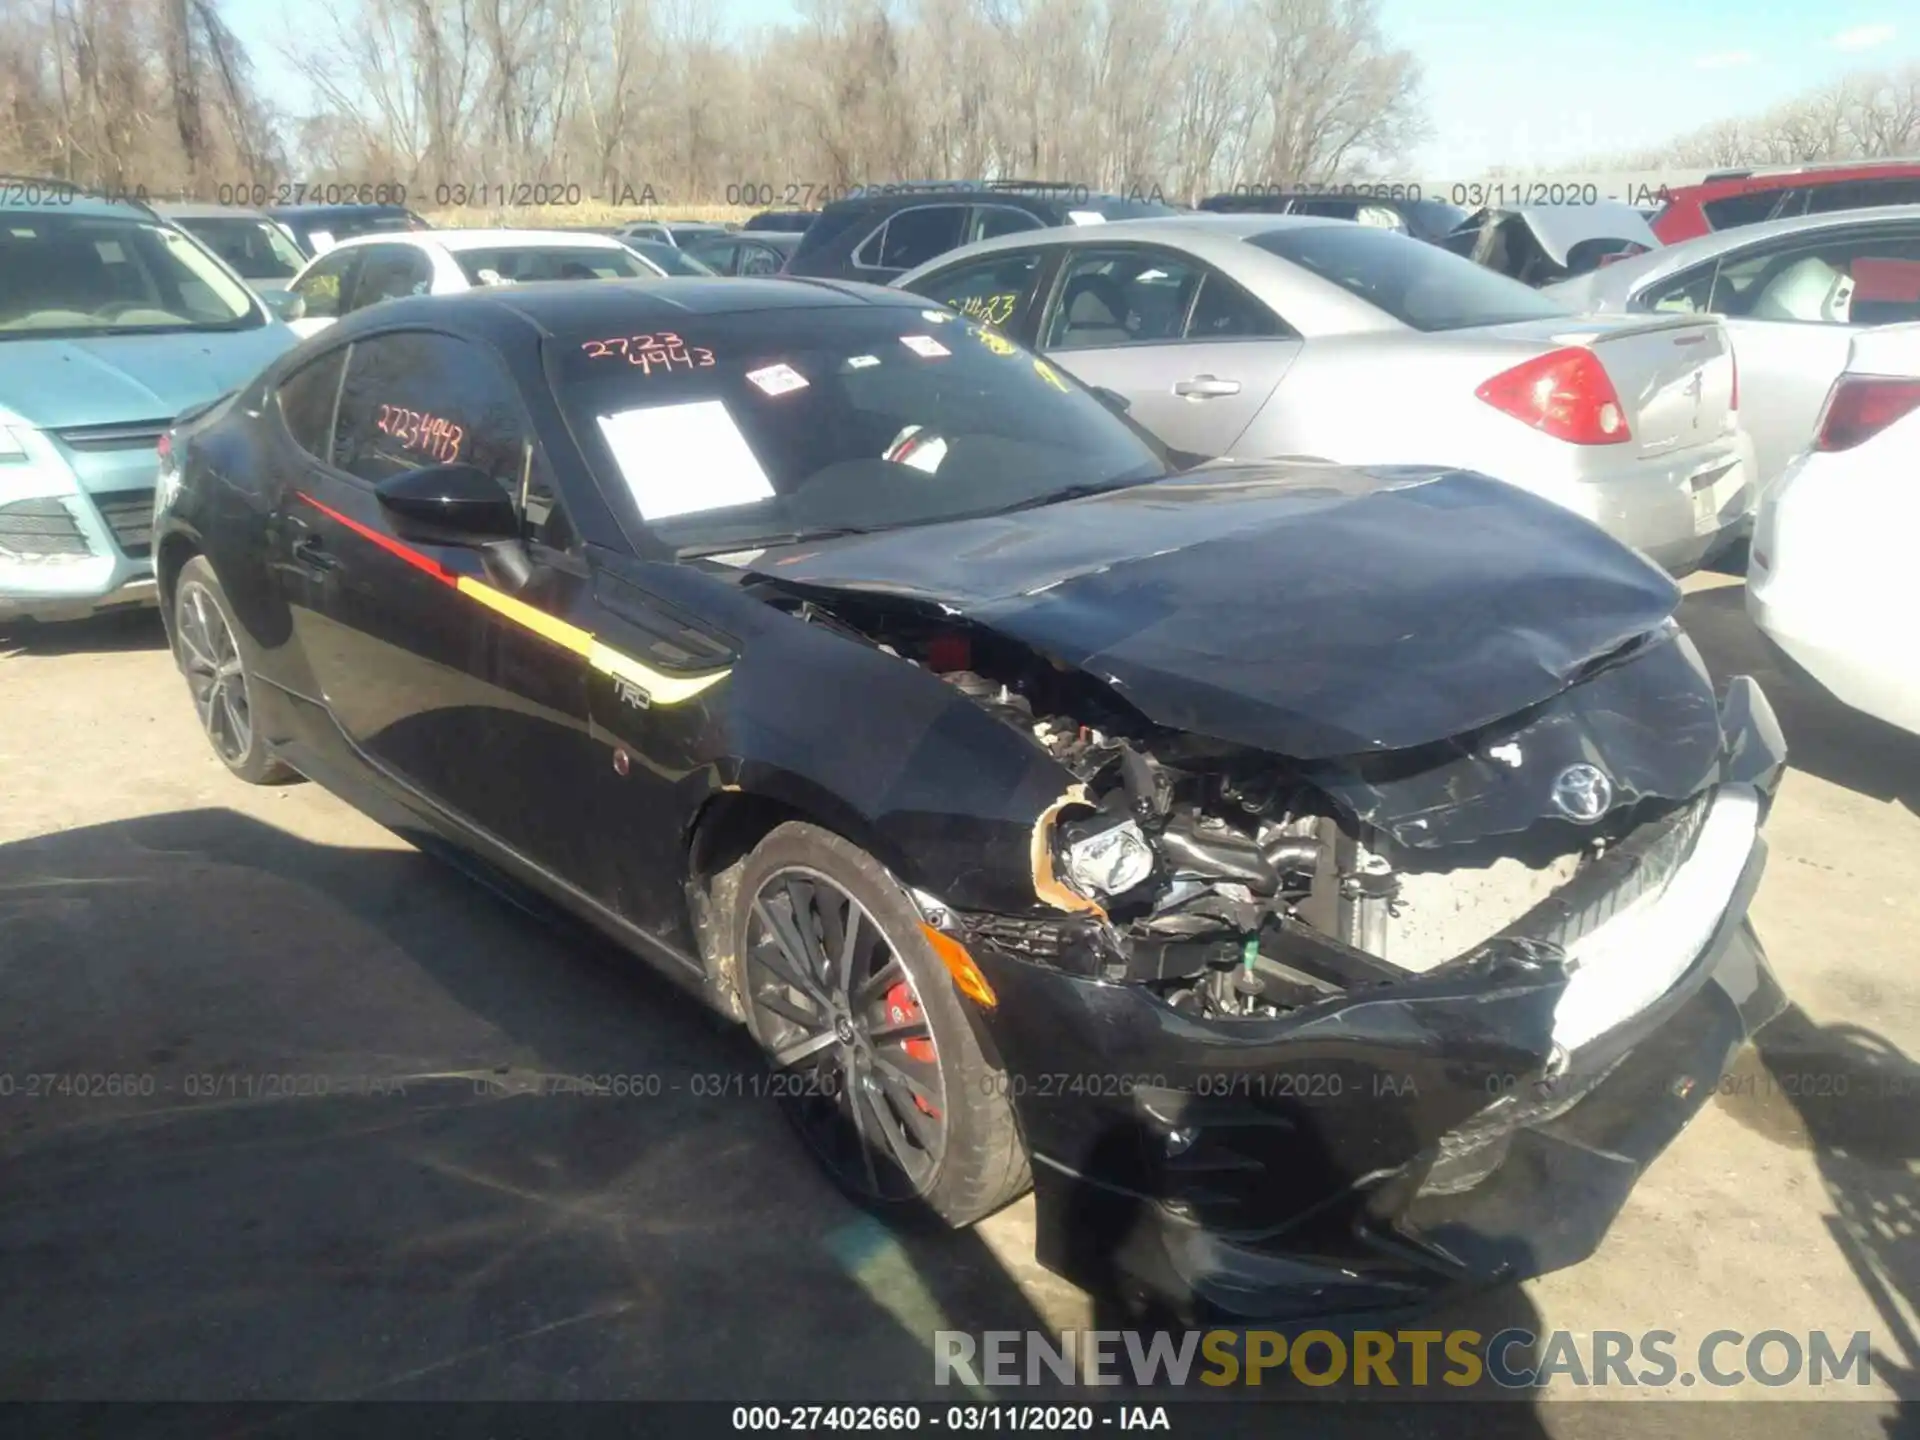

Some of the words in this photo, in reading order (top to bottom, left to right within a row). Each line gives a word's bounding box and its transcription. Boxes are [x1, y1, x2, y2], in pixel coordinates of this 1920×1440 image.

[582, 332, 684, 358] 2723
[628, 348, 716, 374] 4943
[377, 403, 463, 464] 27234943
[612, 674, 651, 710] TRD
